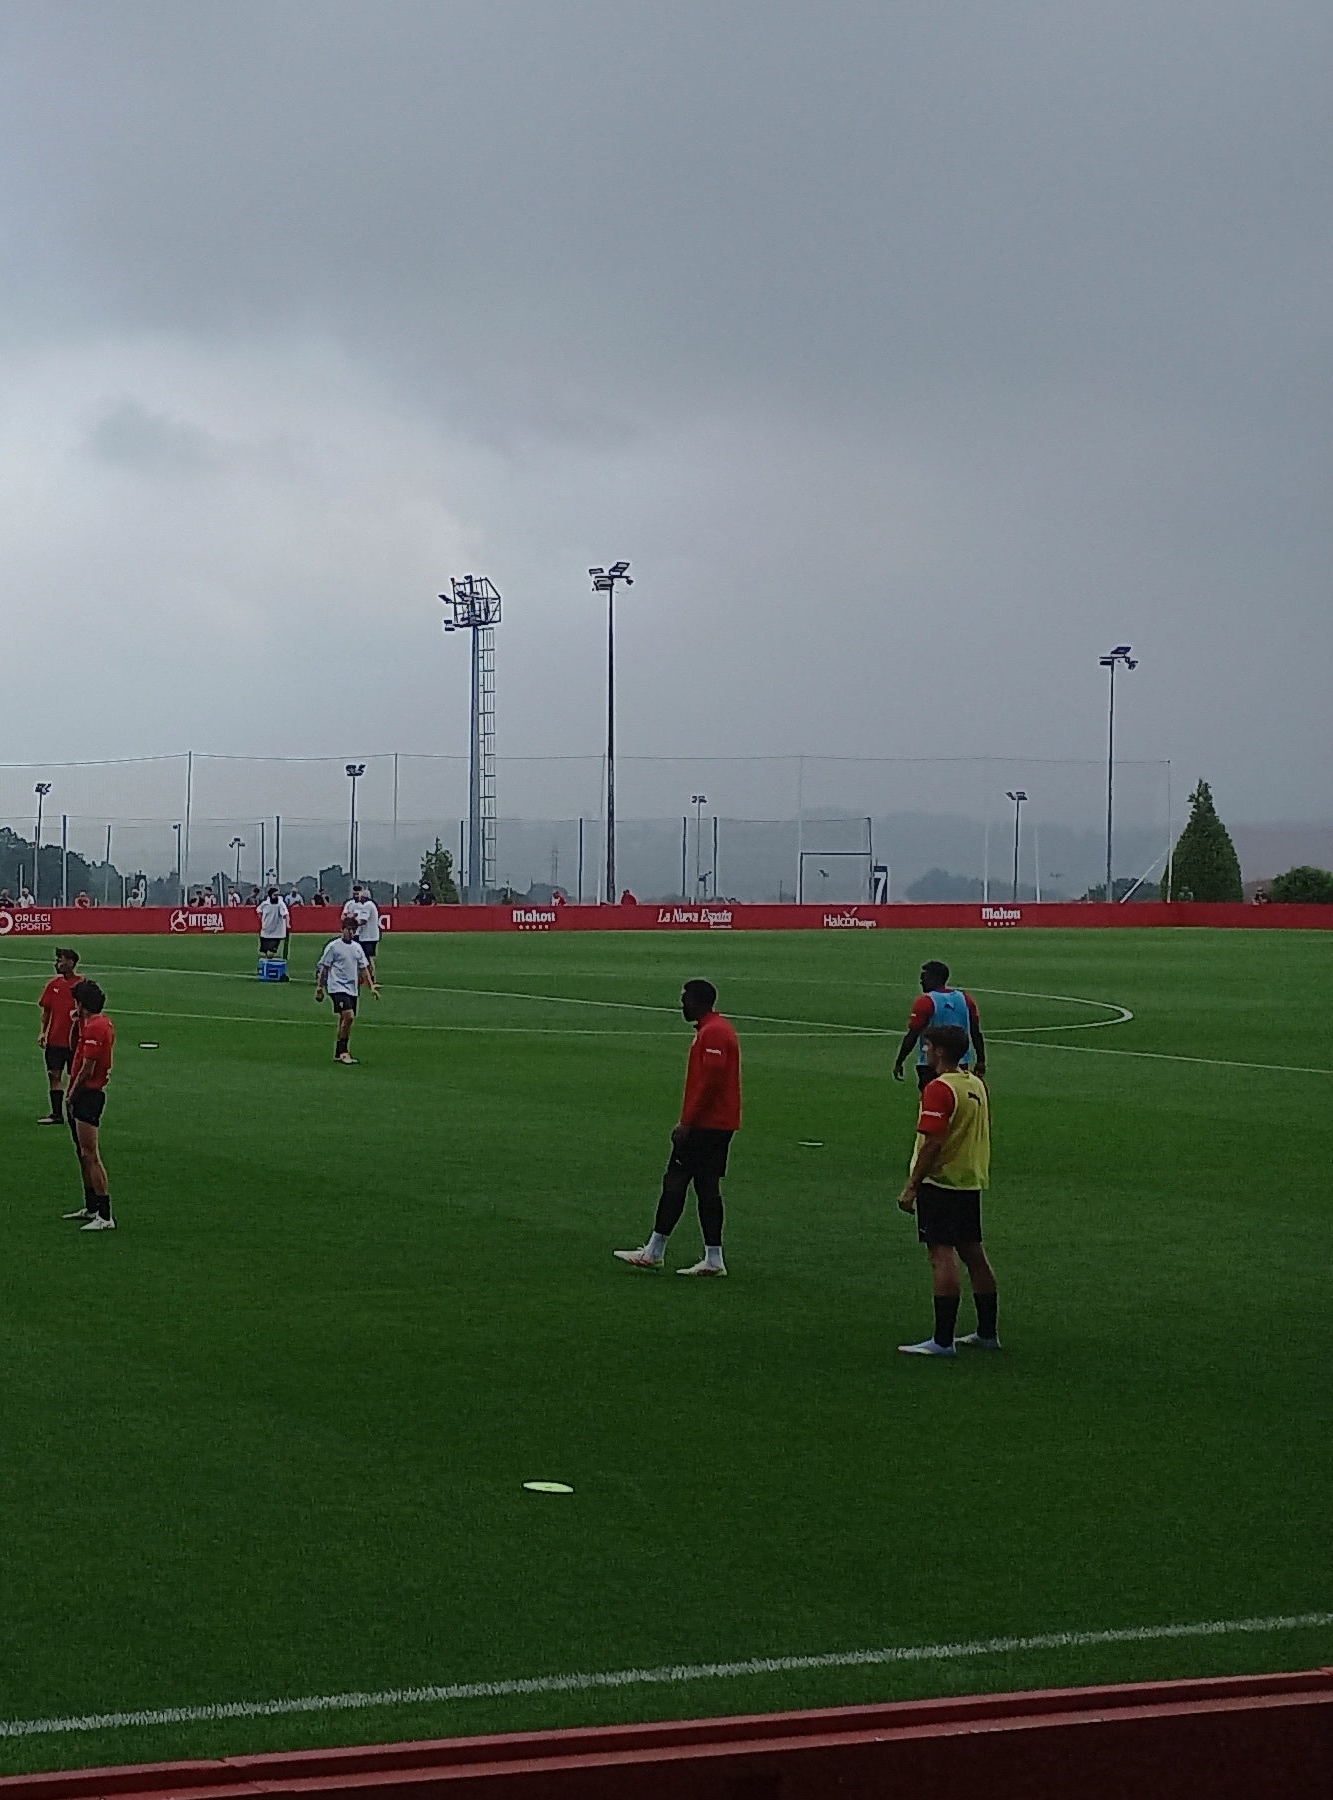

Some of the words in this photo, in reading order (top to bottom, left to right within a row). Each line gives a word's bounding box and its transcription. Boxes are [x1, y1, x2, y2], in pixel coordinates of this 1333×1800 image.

[14, 913, 51, 923] ORLEGI
[188, 913, 224, 927] INTEGRA
[512, 909, 556, 923] Mahou
[657, 908, 671, 923] La
[672, 908, 699, 923] Nueva
[981, 907, 1021, 920] Mahou
[14, 922, 52, 931] SPORTS
